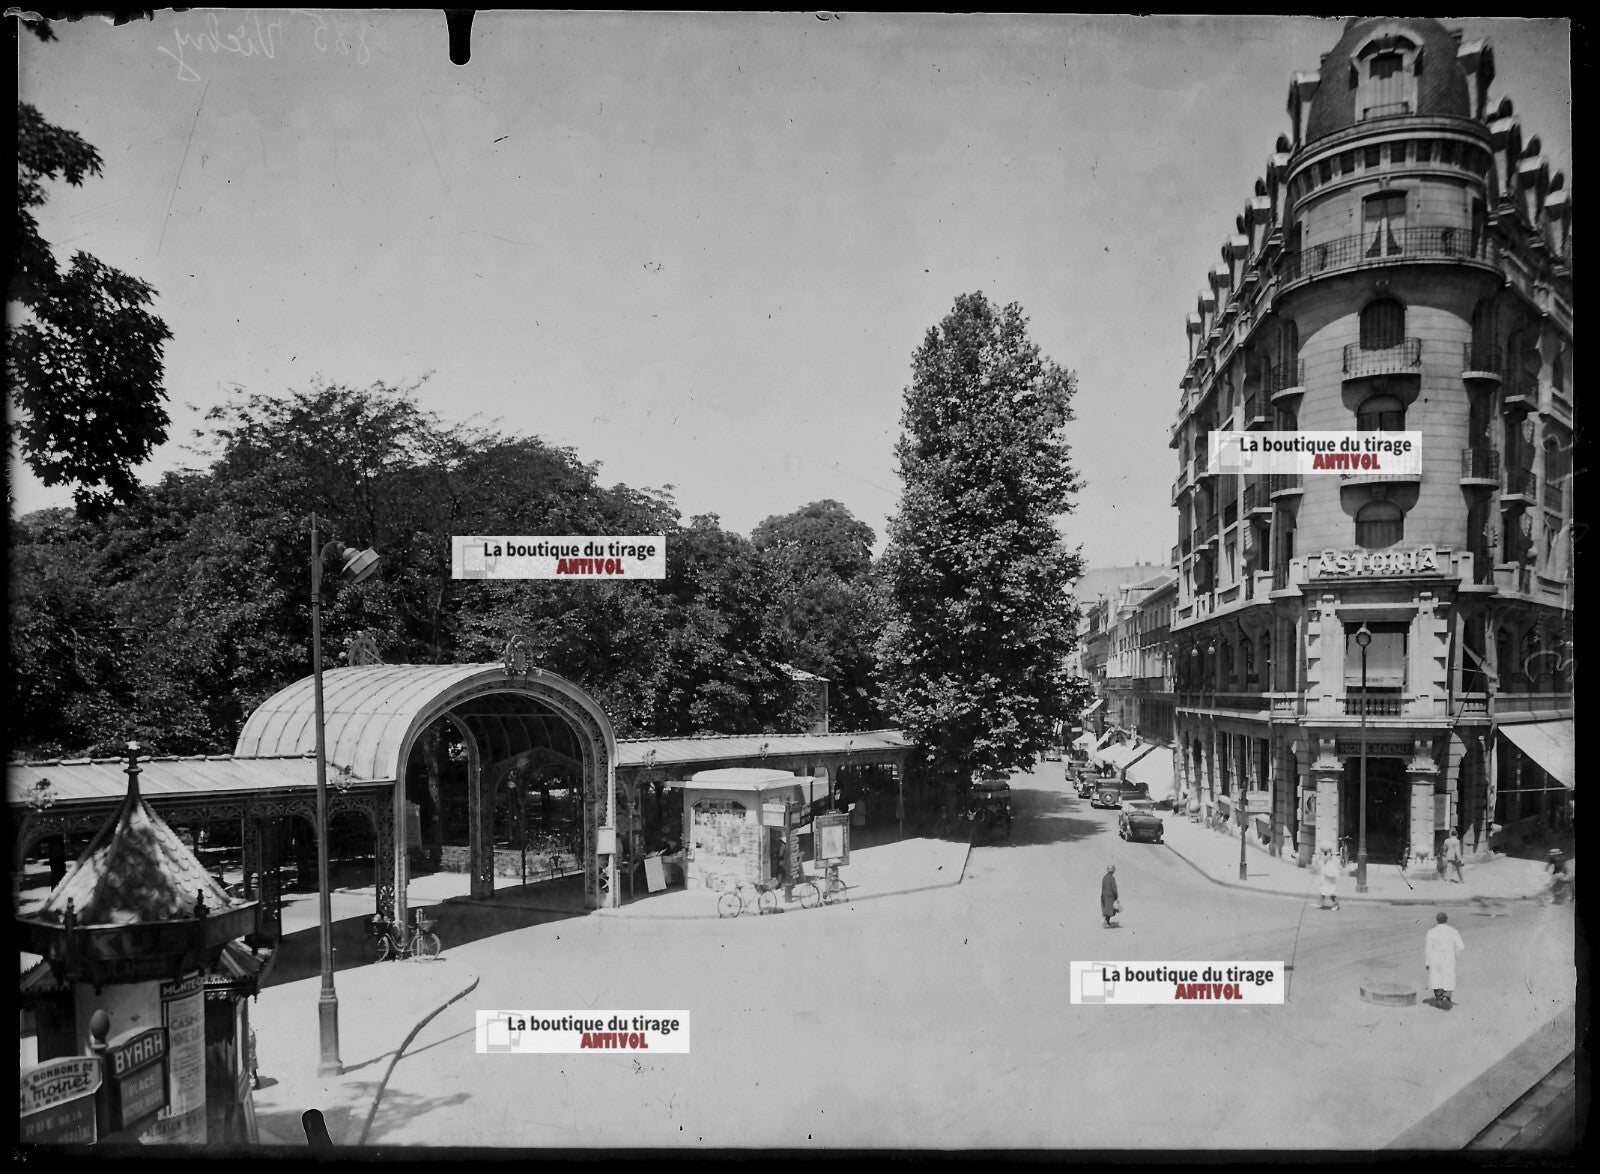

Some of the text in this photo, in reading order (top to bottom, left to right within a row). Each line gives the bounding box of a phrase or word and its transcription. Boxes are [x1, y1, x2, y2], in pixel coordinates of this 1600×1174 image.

[1317, 549, 1439, 574] ASTORIA
[115, 1030, 163, 1074] BYRRH
[33, 1063, 79, 1083] BONBONS
[82, 1062, 94, 1072] DE
